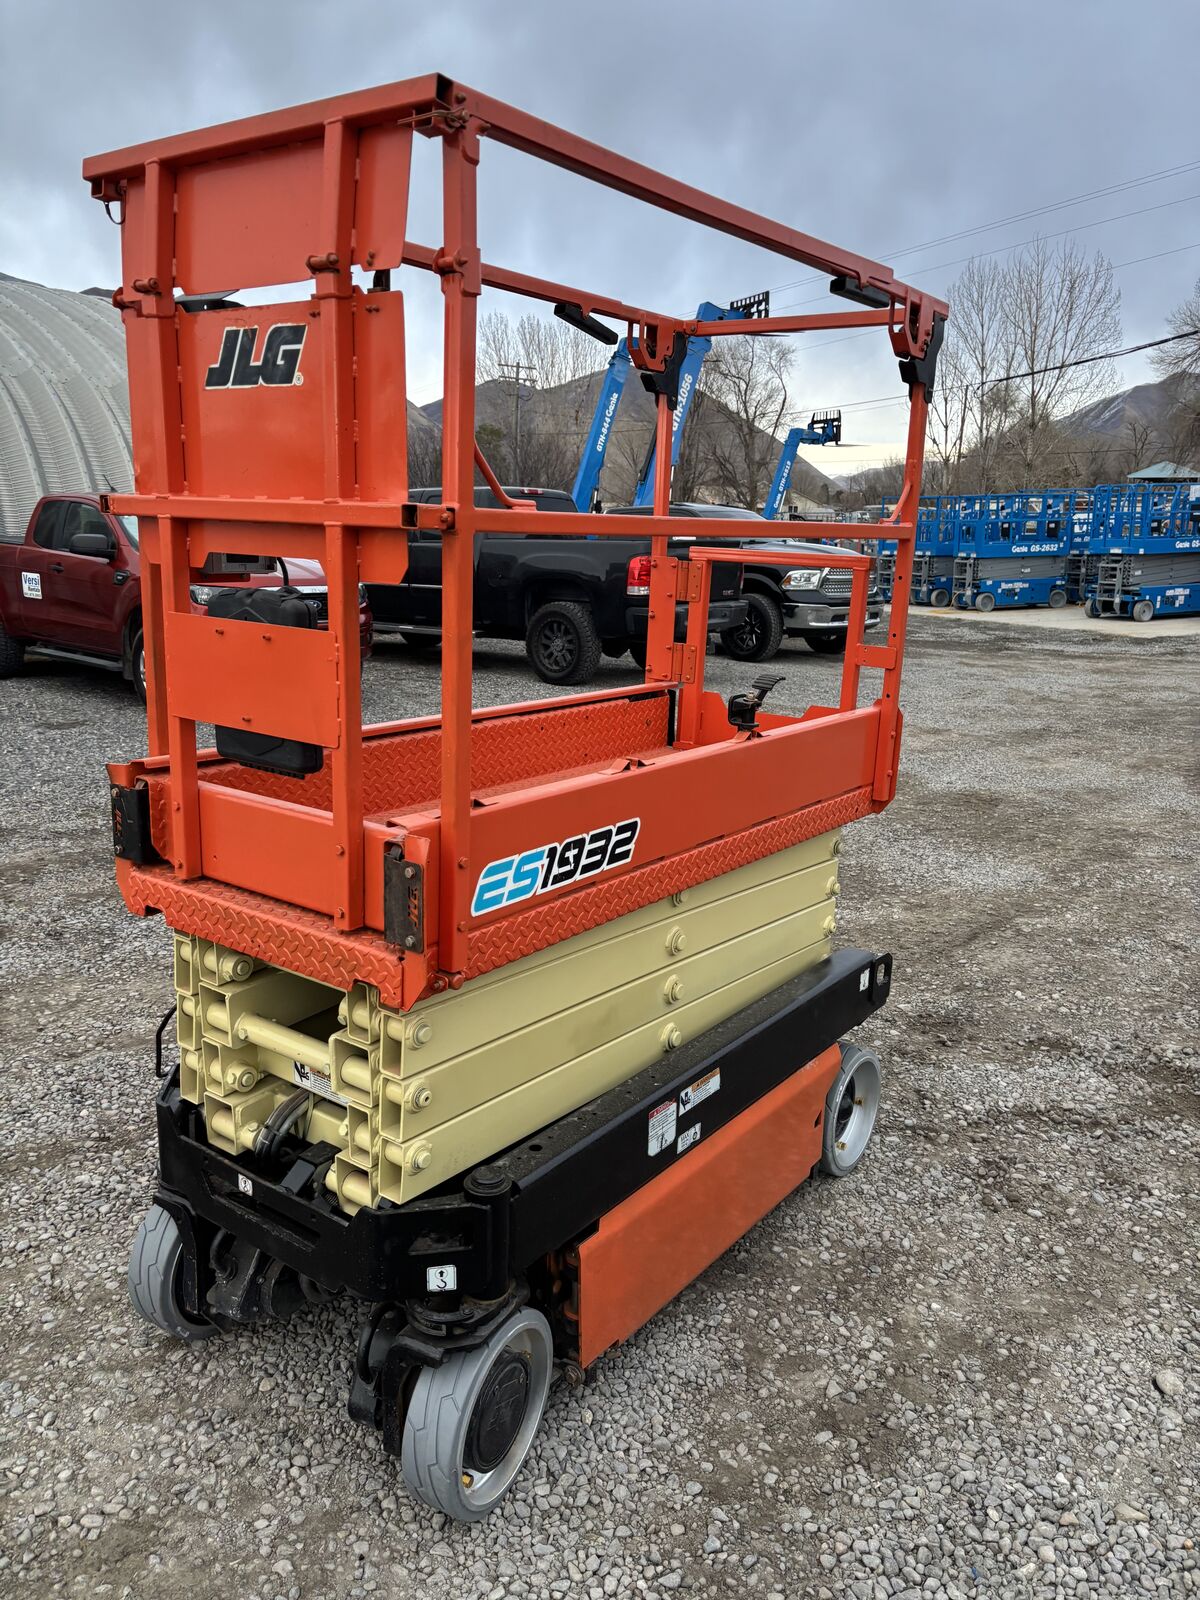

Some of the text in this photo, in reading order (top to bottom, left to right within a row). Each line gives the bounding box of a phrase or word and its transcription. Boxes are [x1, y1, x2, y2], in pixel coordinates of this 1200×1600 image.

[204, 322, 307, 389] JLG
[605, 392, 619, 417] Genie
[1011, 545, 1028, 553] Genie
[22, 573, 40, 586] Versi
[471, 817, 641, 917] ES1932
